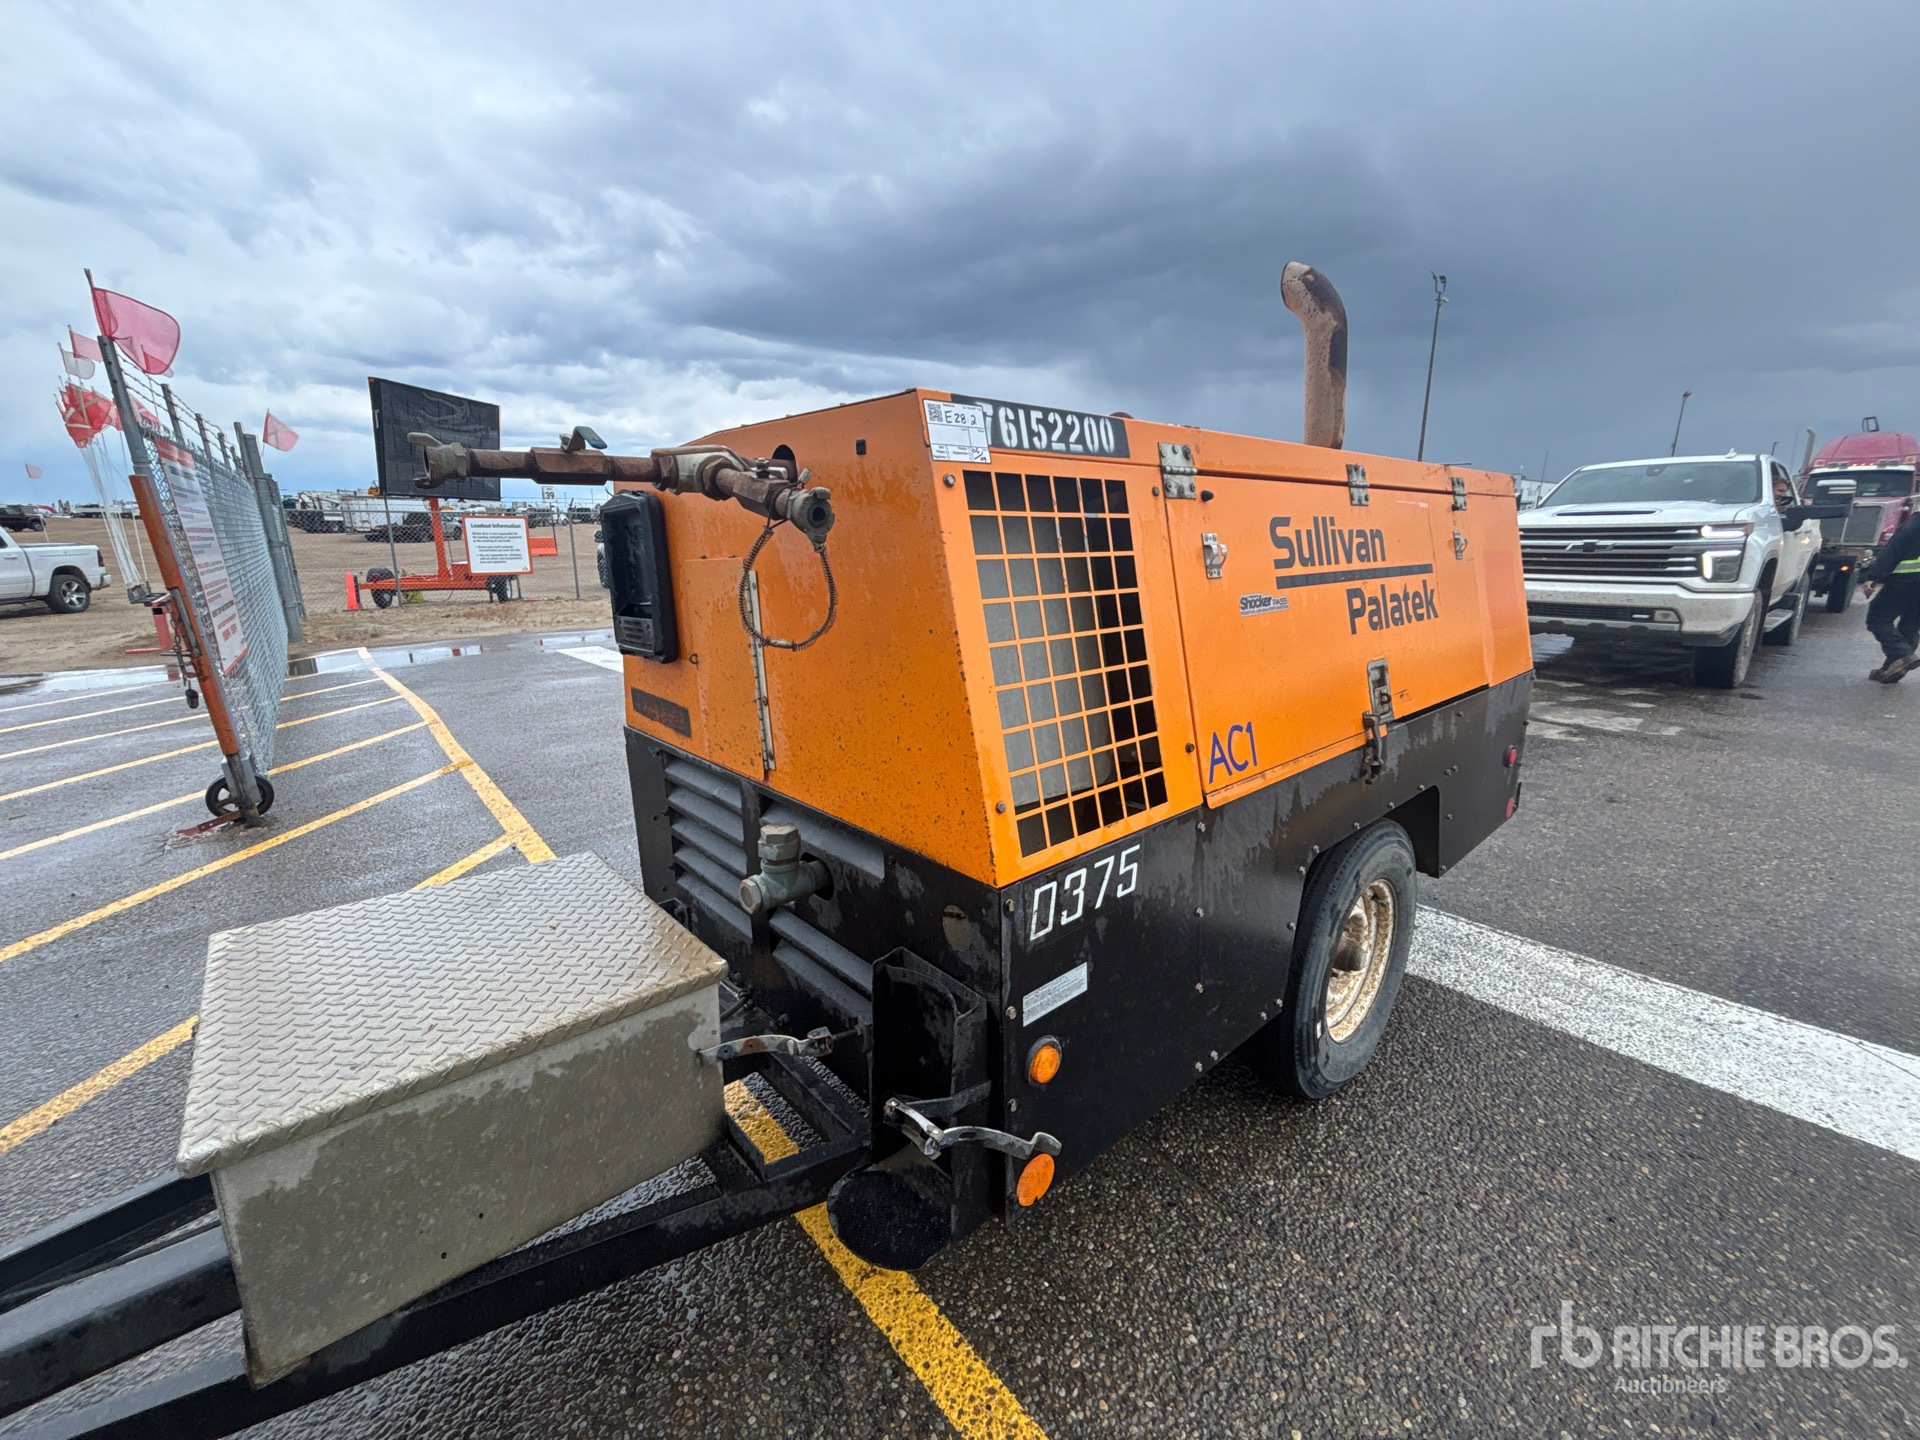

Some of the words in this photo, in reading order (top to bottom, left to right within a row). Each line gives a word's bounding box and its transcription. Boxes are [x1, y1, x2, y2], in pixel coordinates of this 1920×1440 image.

[545, 491, 555, 500] 39
[1269, 516, 1386, 569] Sullivan
[1240, 595, 1272, 611] Shocker
[1346, 579, 1439, 635] Palatek
[1209, 721, 1258, 784] AC1
[1029, 844, 1141, 941] 0375
